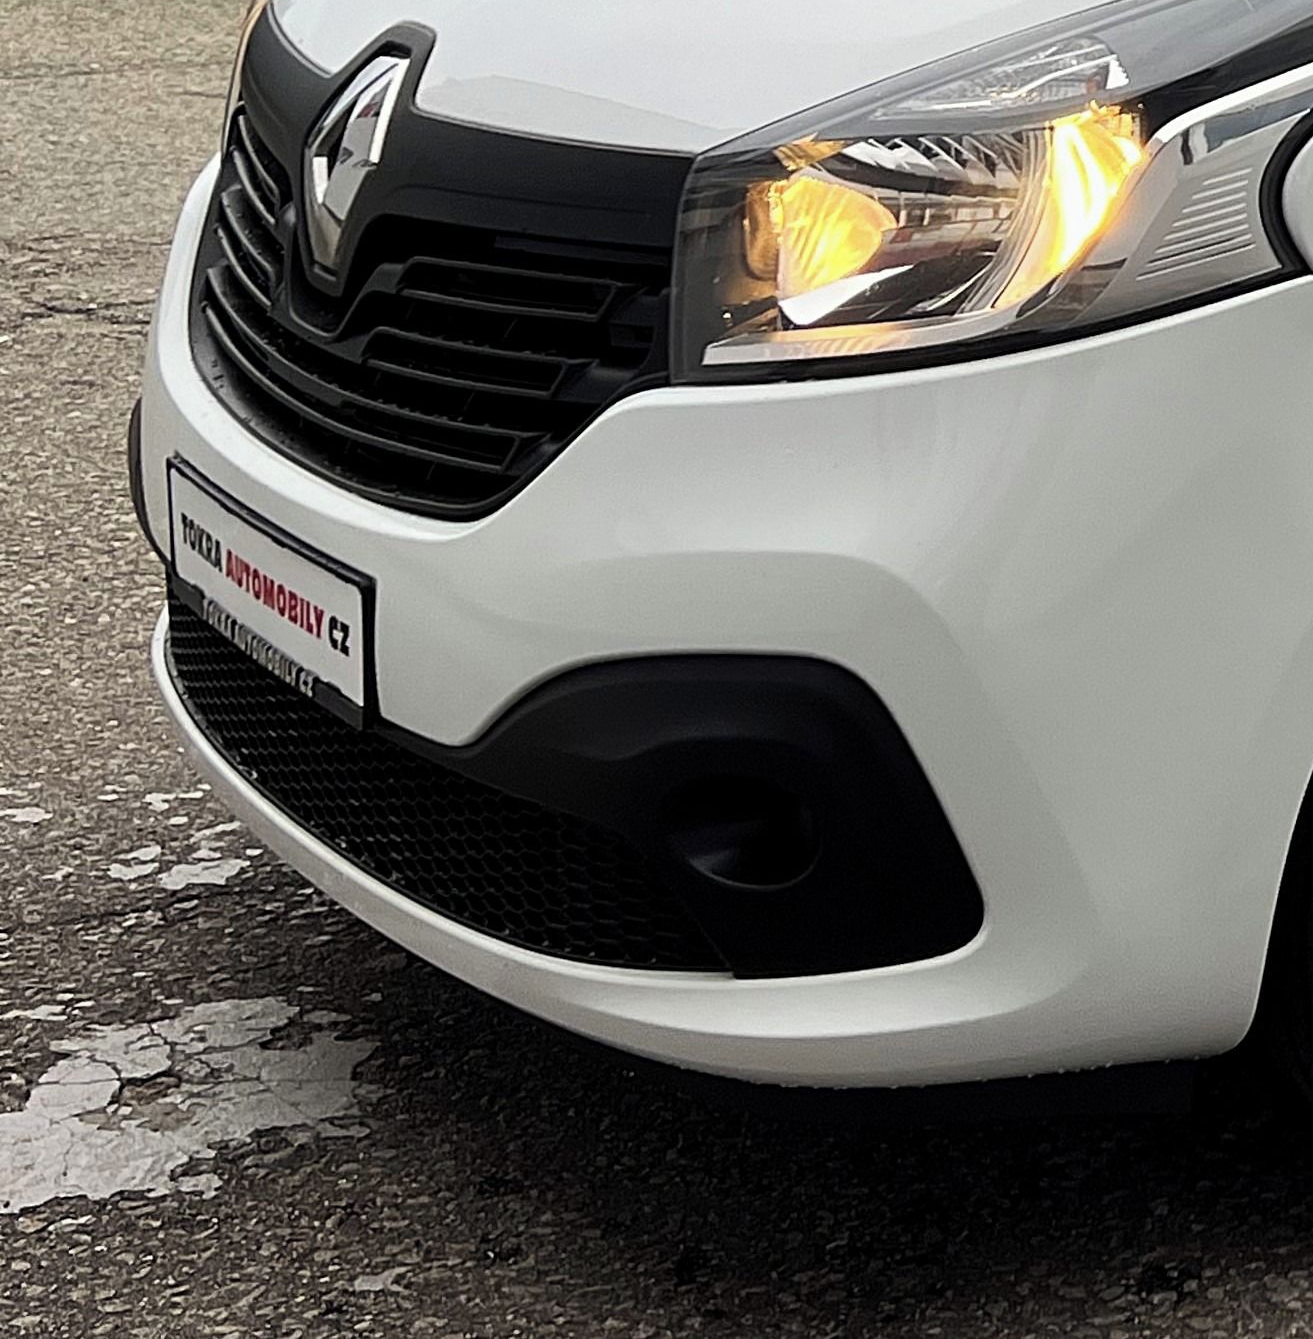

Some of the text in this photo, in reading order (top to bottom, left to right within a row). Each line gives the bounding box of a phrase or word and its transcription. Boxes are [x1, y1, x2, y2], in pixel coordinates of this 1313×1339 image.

[181, 512, 350, 656] TOKRA AUTOMOBILY CZ
